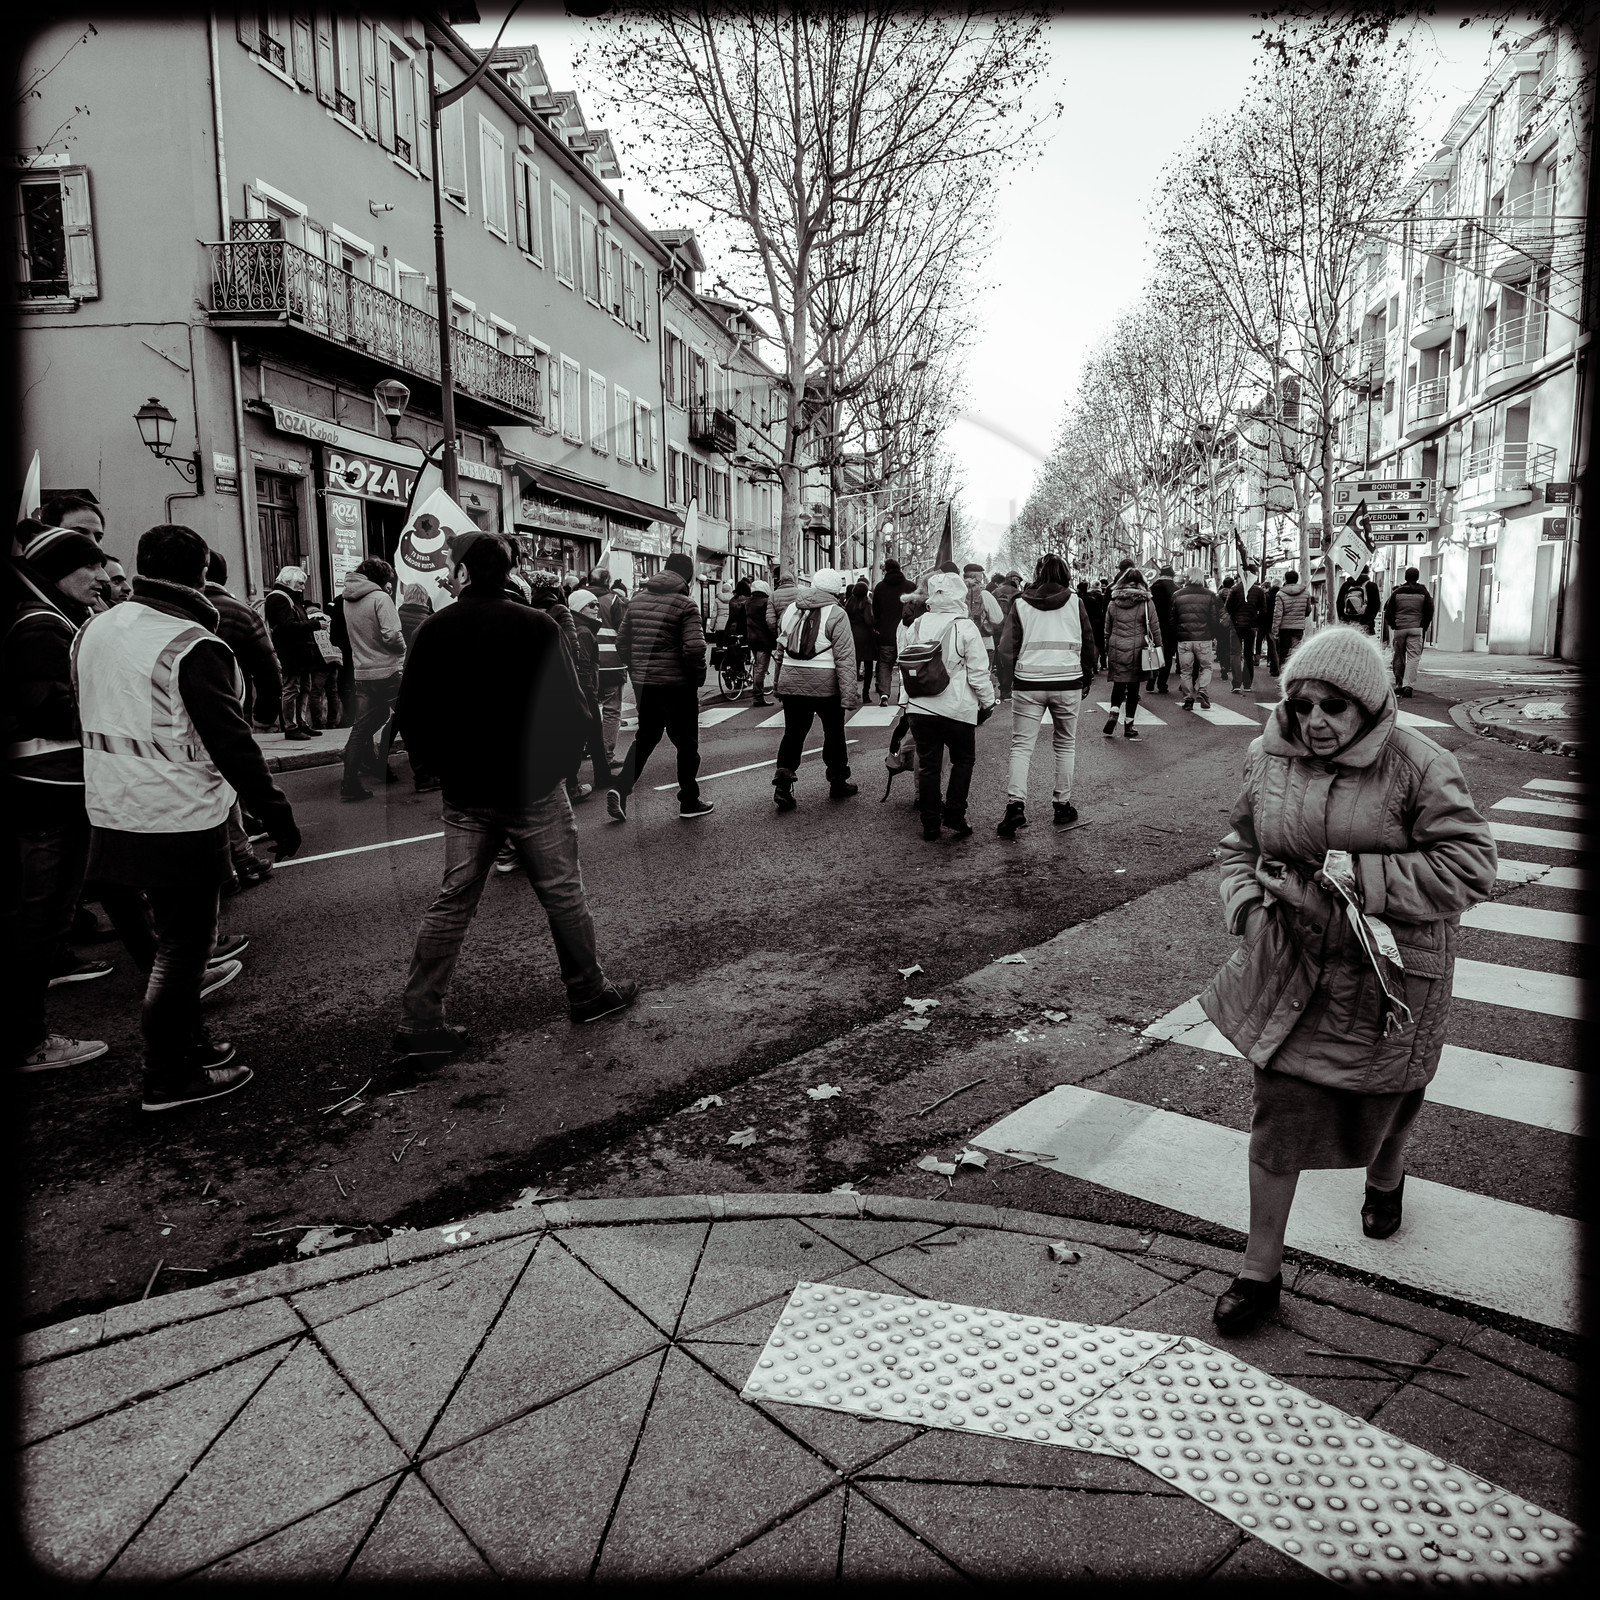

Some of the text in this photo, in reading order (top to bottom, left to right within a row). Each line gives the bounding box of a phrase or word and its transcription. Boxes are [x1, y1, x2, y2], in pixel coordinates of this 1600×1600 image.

[277, 410, 338, 444] ROZA Kebab
[329, 454, 400, 497] ROZA
[1339, 491, 1410, 502] P 128
[332, 502, 358, 520] ROZA
[1338, 514, 1345, 523] P
